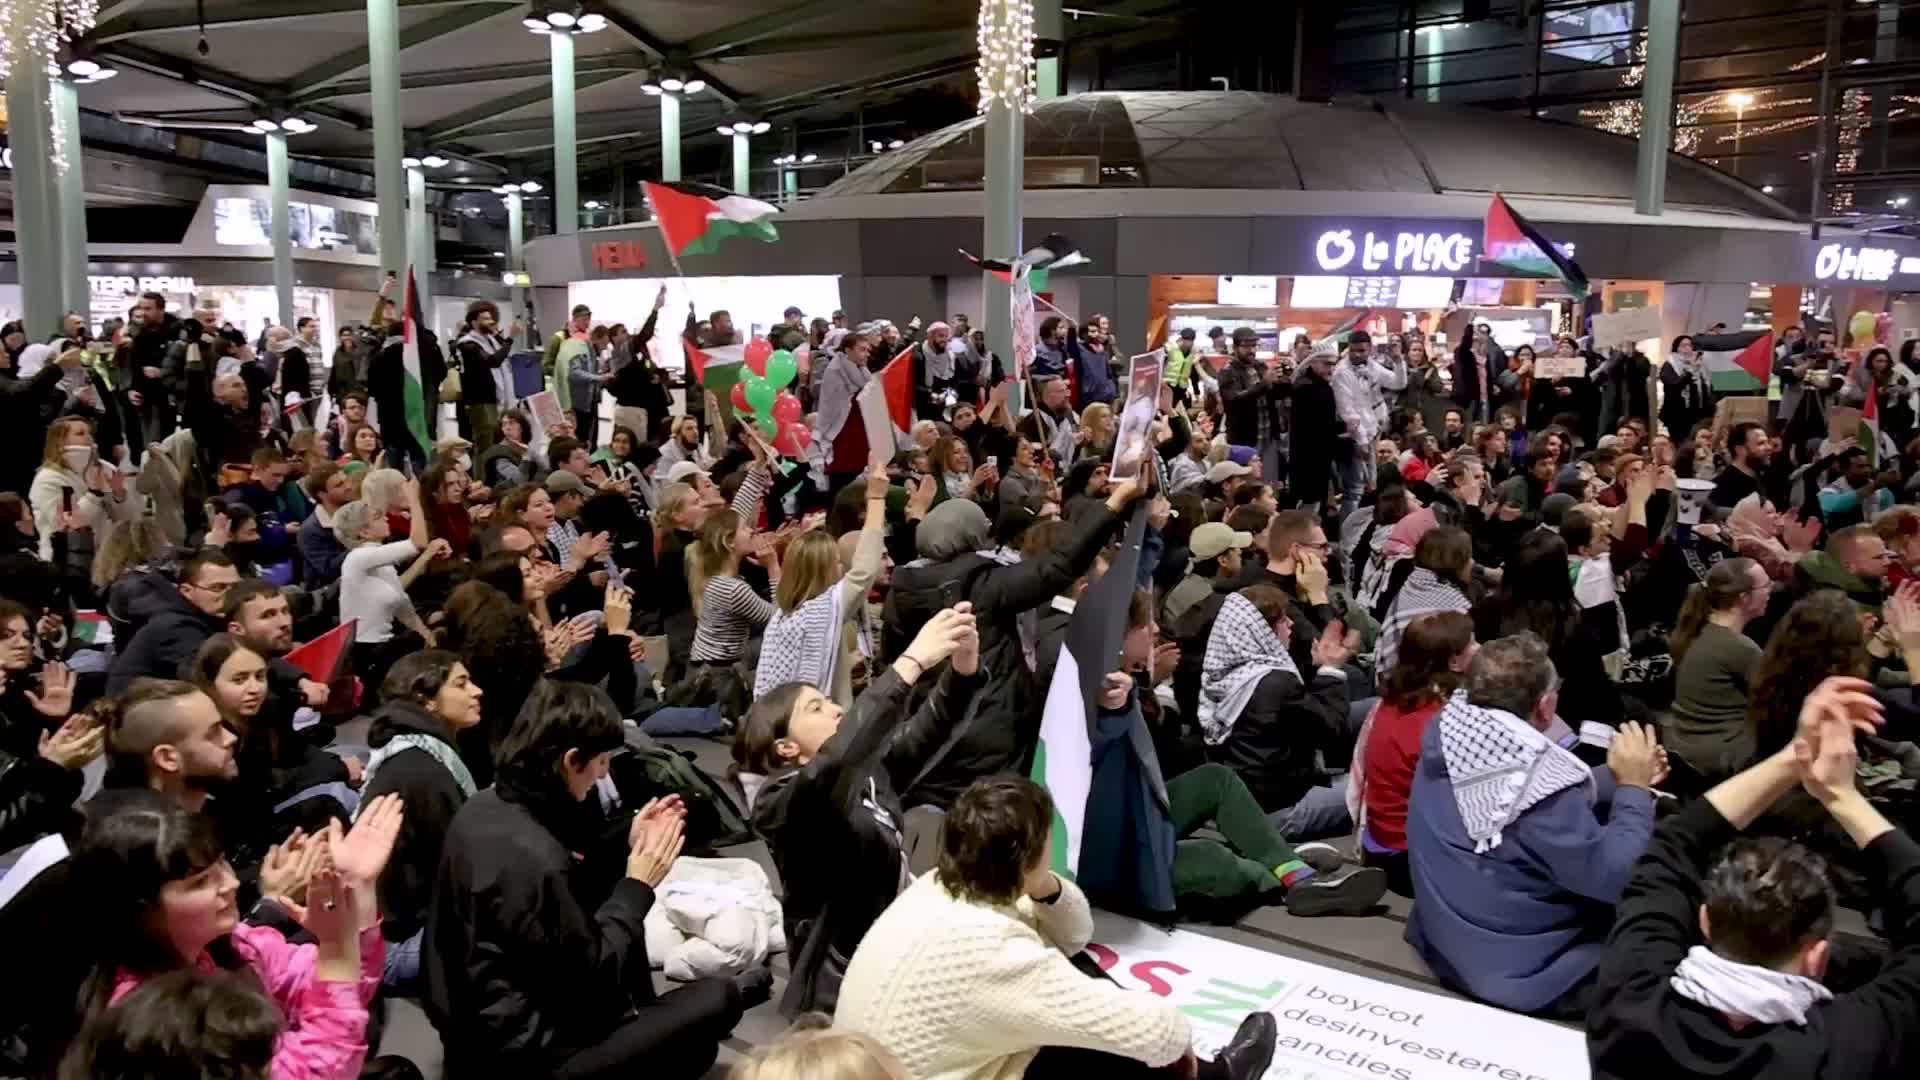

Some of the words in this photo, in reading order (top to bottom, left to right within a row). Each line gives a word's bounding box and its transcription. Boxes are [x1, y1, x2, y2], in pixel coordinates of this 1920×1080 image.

[1394, 232, 1473, 272] PLACE
[1304, 985, 1425, 1027] boycot
[1278, 1034, 1413, 1080] ancties
